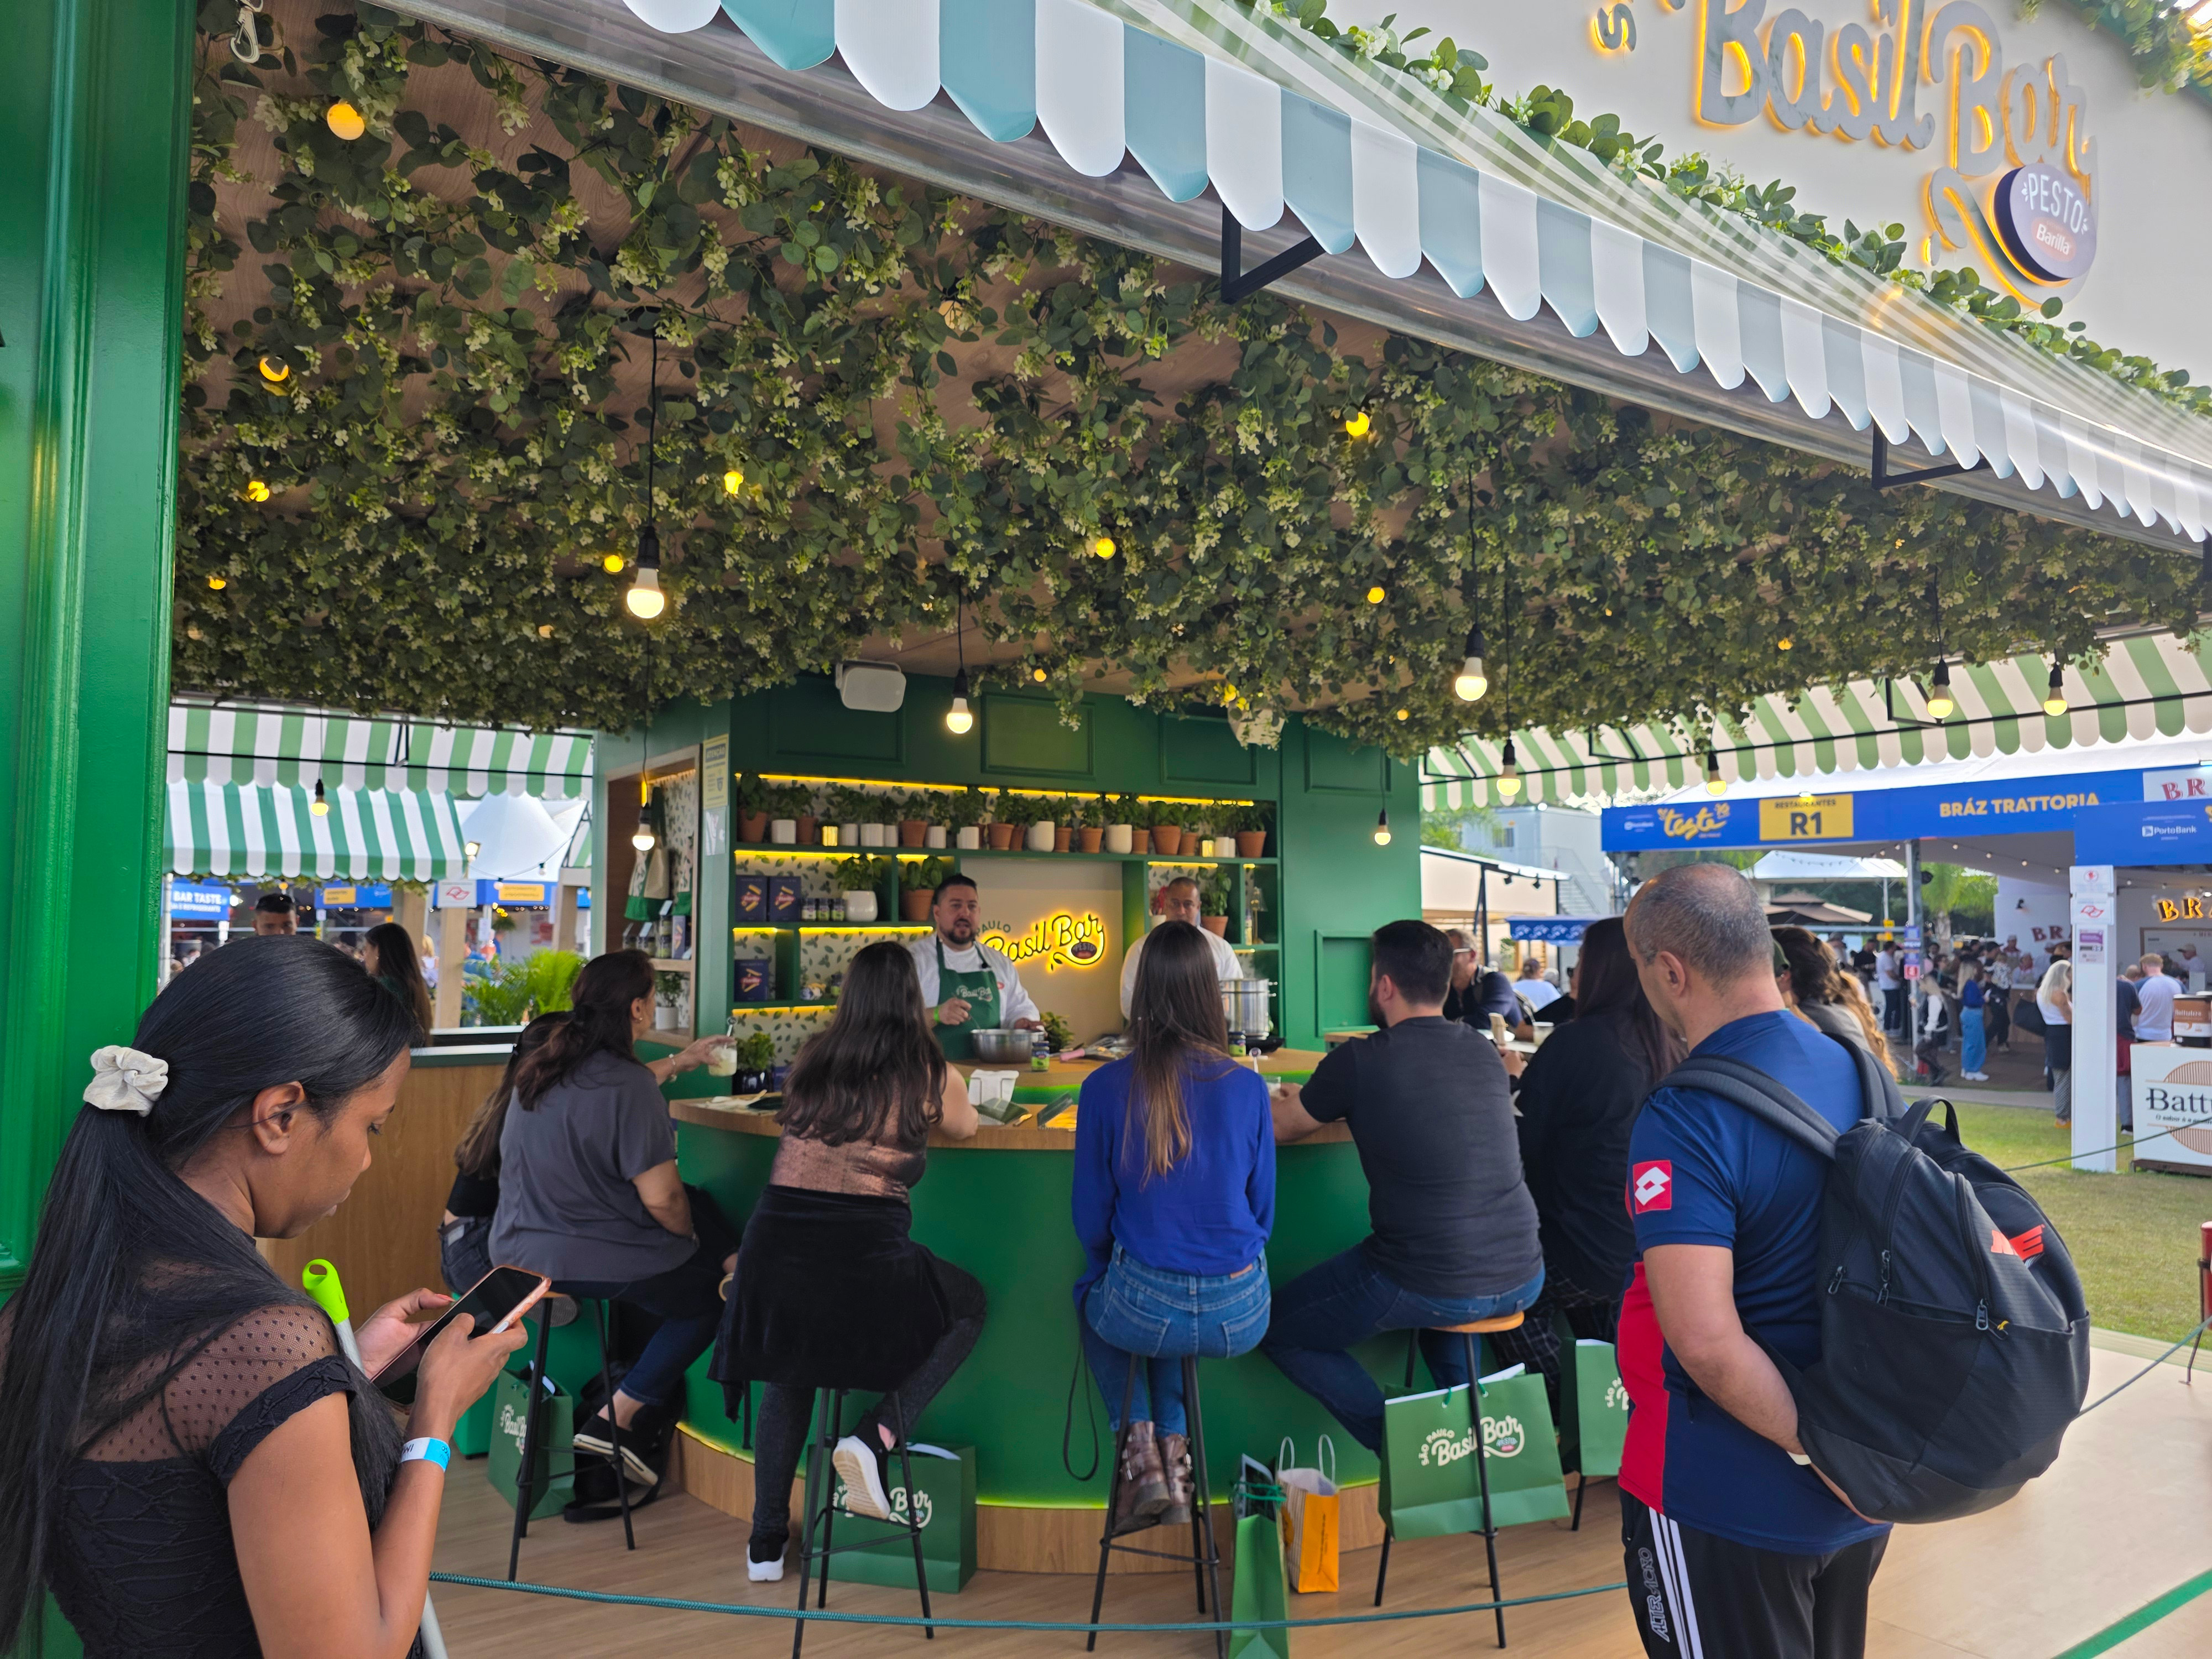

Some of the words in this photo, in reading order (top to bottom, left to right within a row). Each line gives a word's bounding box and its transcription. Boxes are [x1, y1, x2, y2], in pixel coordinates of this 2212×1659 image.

[1665, 0, 1936, 149] Basil
[1927, 1, 2099, 188] Bar
[2027, 172, 2084, 234] PESTO
[2036, 223, 2071, 256] Barilla
[1939, 798, 1988, 817] BRÁZ
[1991, 792, 2100, 814] TRATTORIA
[1790, 810, 1822, 836] R1
[1051, 914, 1104, 947] Bar
[1426, 1428, 1455, 1444] PAULO
[1480, 1415, 1522, 1445] Bar
